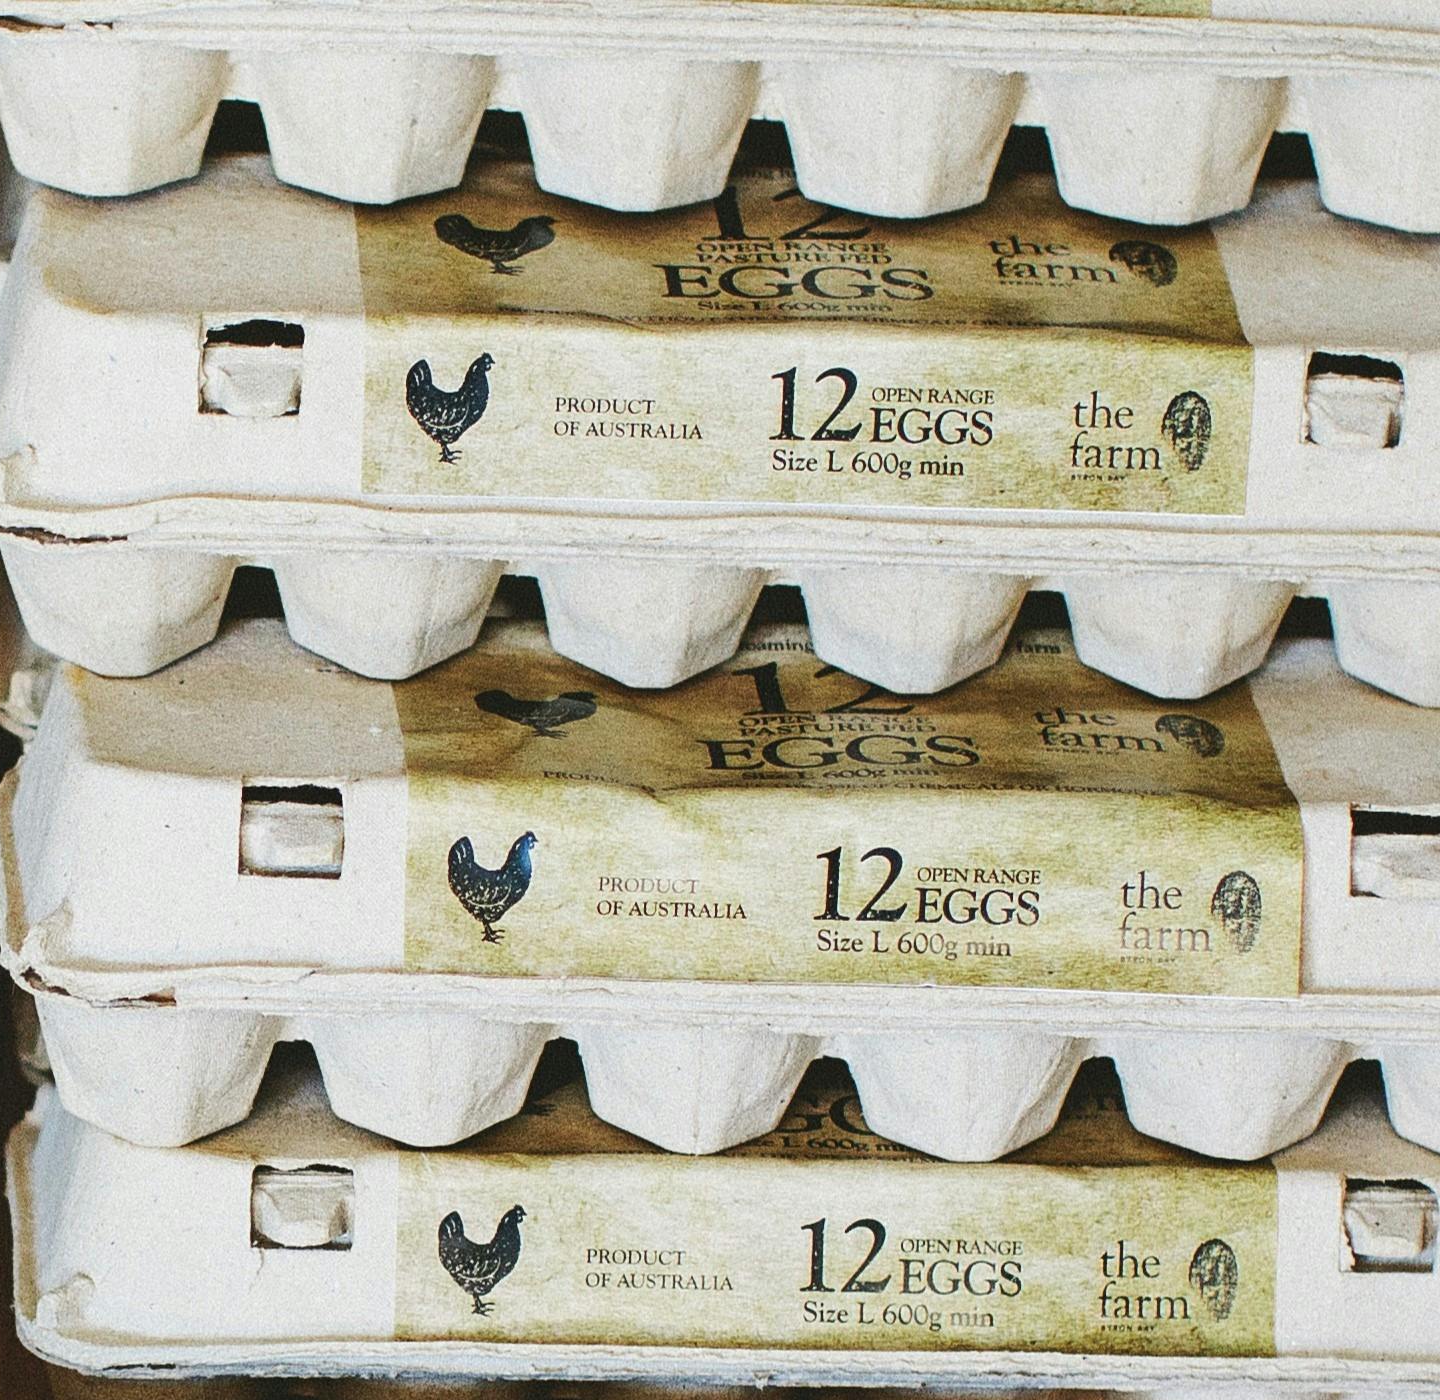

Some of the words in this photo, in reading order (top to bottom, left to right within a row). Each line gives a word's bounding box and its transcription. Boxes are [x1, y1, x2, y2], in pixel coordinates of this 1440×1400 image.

[701, 186, 870, 240] 12
[696, 242, 773, 252] OPEN
[784, 242, 886, 253] RANGE
[696, 252, 827, 264] PASTURE
[839, 254, 892, 264] FED
[988, 234, 1070, 257] the
[652, 264, 934, 300] EGGS
[992, 256, 1119, 283] farm
[556, 397, 655, 415] PRODUCT
[769, 367, 862, 442] 12
[872, 387, 922, 403] OPEN
[928, 389, 994, 405] RANGE
[1074, 391, 1134, 428] the
[554, 421, 580, 437] OF
[586, 423, 703, 440] AUSTRALIA
[870, 408, 993, 446] EGGS
[772, 450, 818, 472] Size
[828, 451, 843, 472] L
[852, 452, 912, 480] 600g
[920, 456, 964, 476] min
[1071, 431, 1161, 470] farm
[732, 662, 915, 715] 12
[738, 714, 817, 725] OPEN
[823, 714, 928, 725] RANGE
[740, 724, 873, 737] PASTURE
[881, 723, 936, 733] FED
[1032, 707, 1119, 726] the
[697, 735, 980, 770] EGGS
[1038, 725, 1166, 752] farm
[599, 876, 699, 894] PRODUCT
[814, 846, 908, 922] 12
[917, 867, 968, 882] OPEN
[974, 868, 1040, 885] RANGE
[1120, 870, 1182, 910] the
[597, 900, 623, 916] OF
[629, 902, 747, 920] AUSTRALIA
[915, 887, 1040, 926] EGGS
[818, 930, 863, 952] Size
[873, 931, 889, 953] L
[898, 932, 957, 960] 600g
[966, 936, 1011, 956] min
[1118, 912, 1212, 952] farm
[587, 1249, 686, 1266] PRODUCT
[800, 1218, 891, 1293] 12
[901, 1239, 951, 1253] OPEN
[957, 1240, 1022, 1256] RANGE
[1100, 1241, 1161, 1278] the
[585, 1273, 611, 1288] OF
[618, 1274, 733, 1291] AUSTRALIA
[899, 1258, 1021, 1297] EGGS
[1099, 1281, 1189, 1320] farm
[803, 1301, 849, 1324] Size
[859, 1302, 874, 1324] L
[882, 1304, 942, 1331] 600g
[951, 1308, 994, 1327] min
